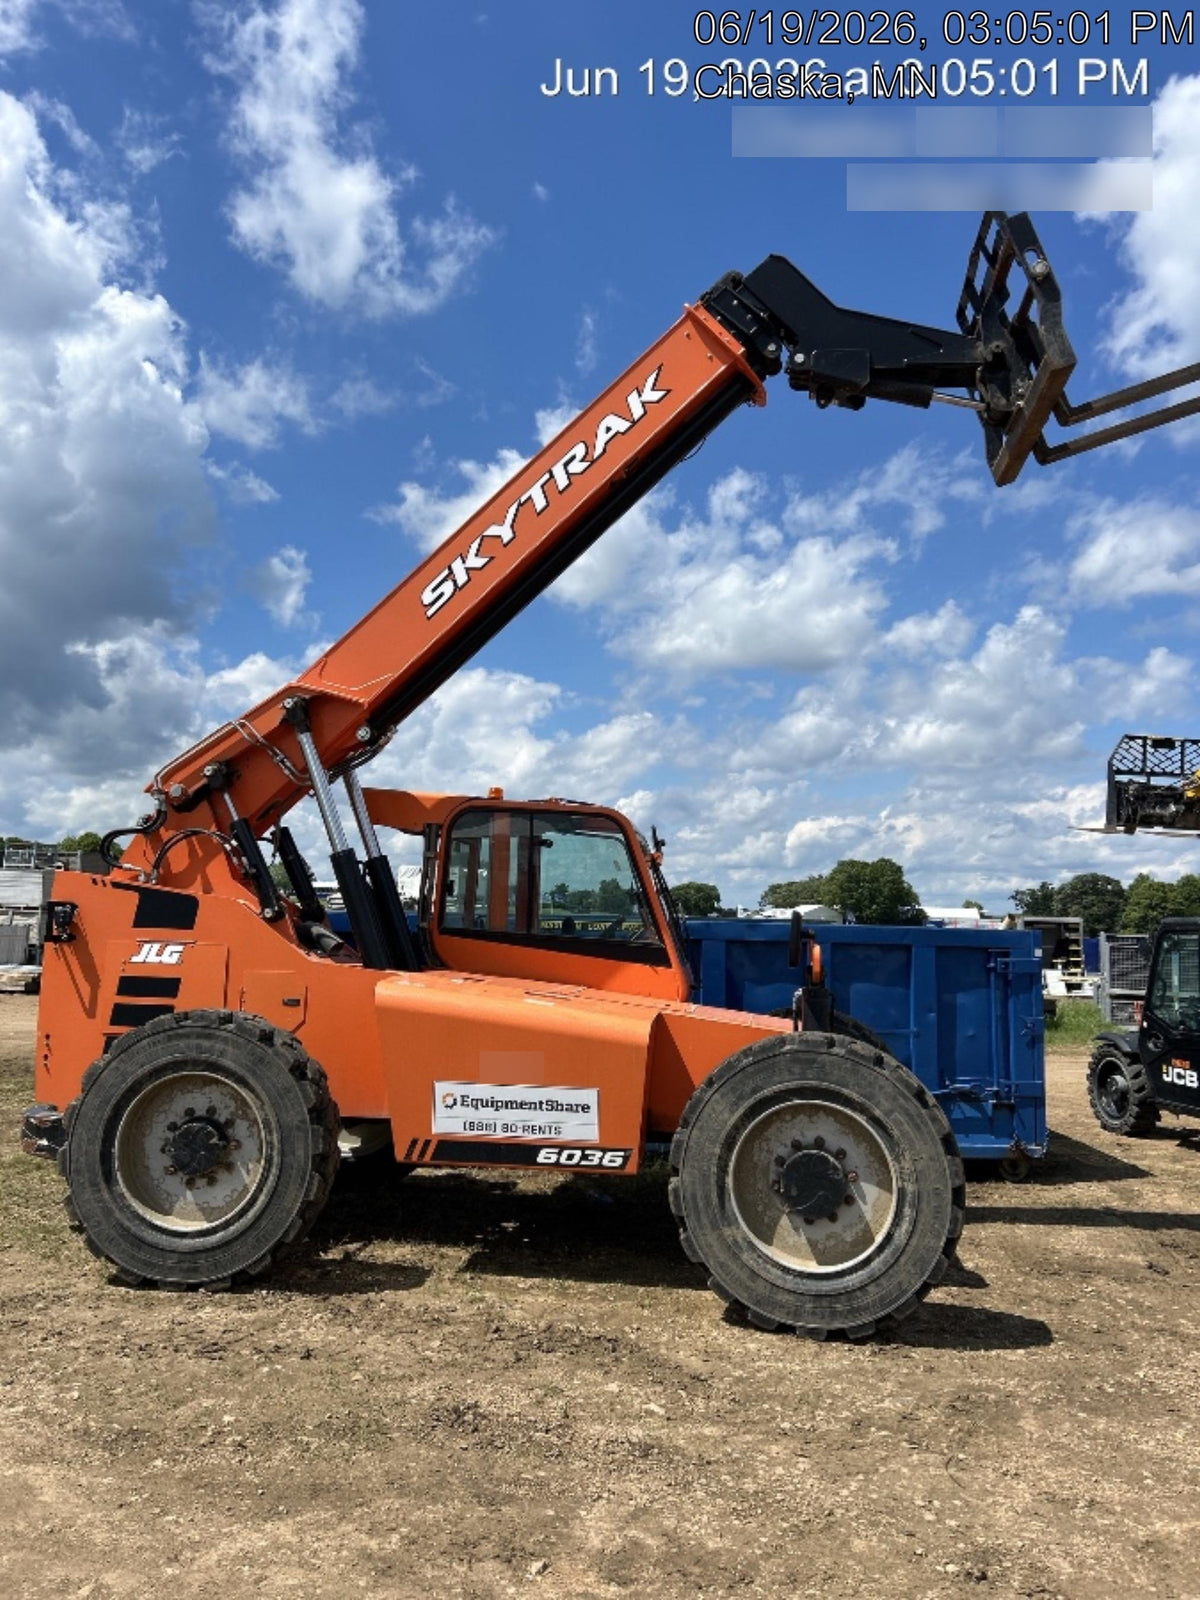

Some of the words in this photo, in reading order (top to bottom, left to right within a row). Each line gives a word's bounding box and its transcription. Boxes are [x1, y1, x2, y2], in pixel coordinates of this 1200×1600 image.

[420, 363, 672, 619] SKYTRAK
[128, 943, 186, 964] JLG
[1162, 1066, 1199, 1088] JCB
[459, 1094, 591, 1114] EquipmentShare
[536, 1148, 625, 1168] 6036
